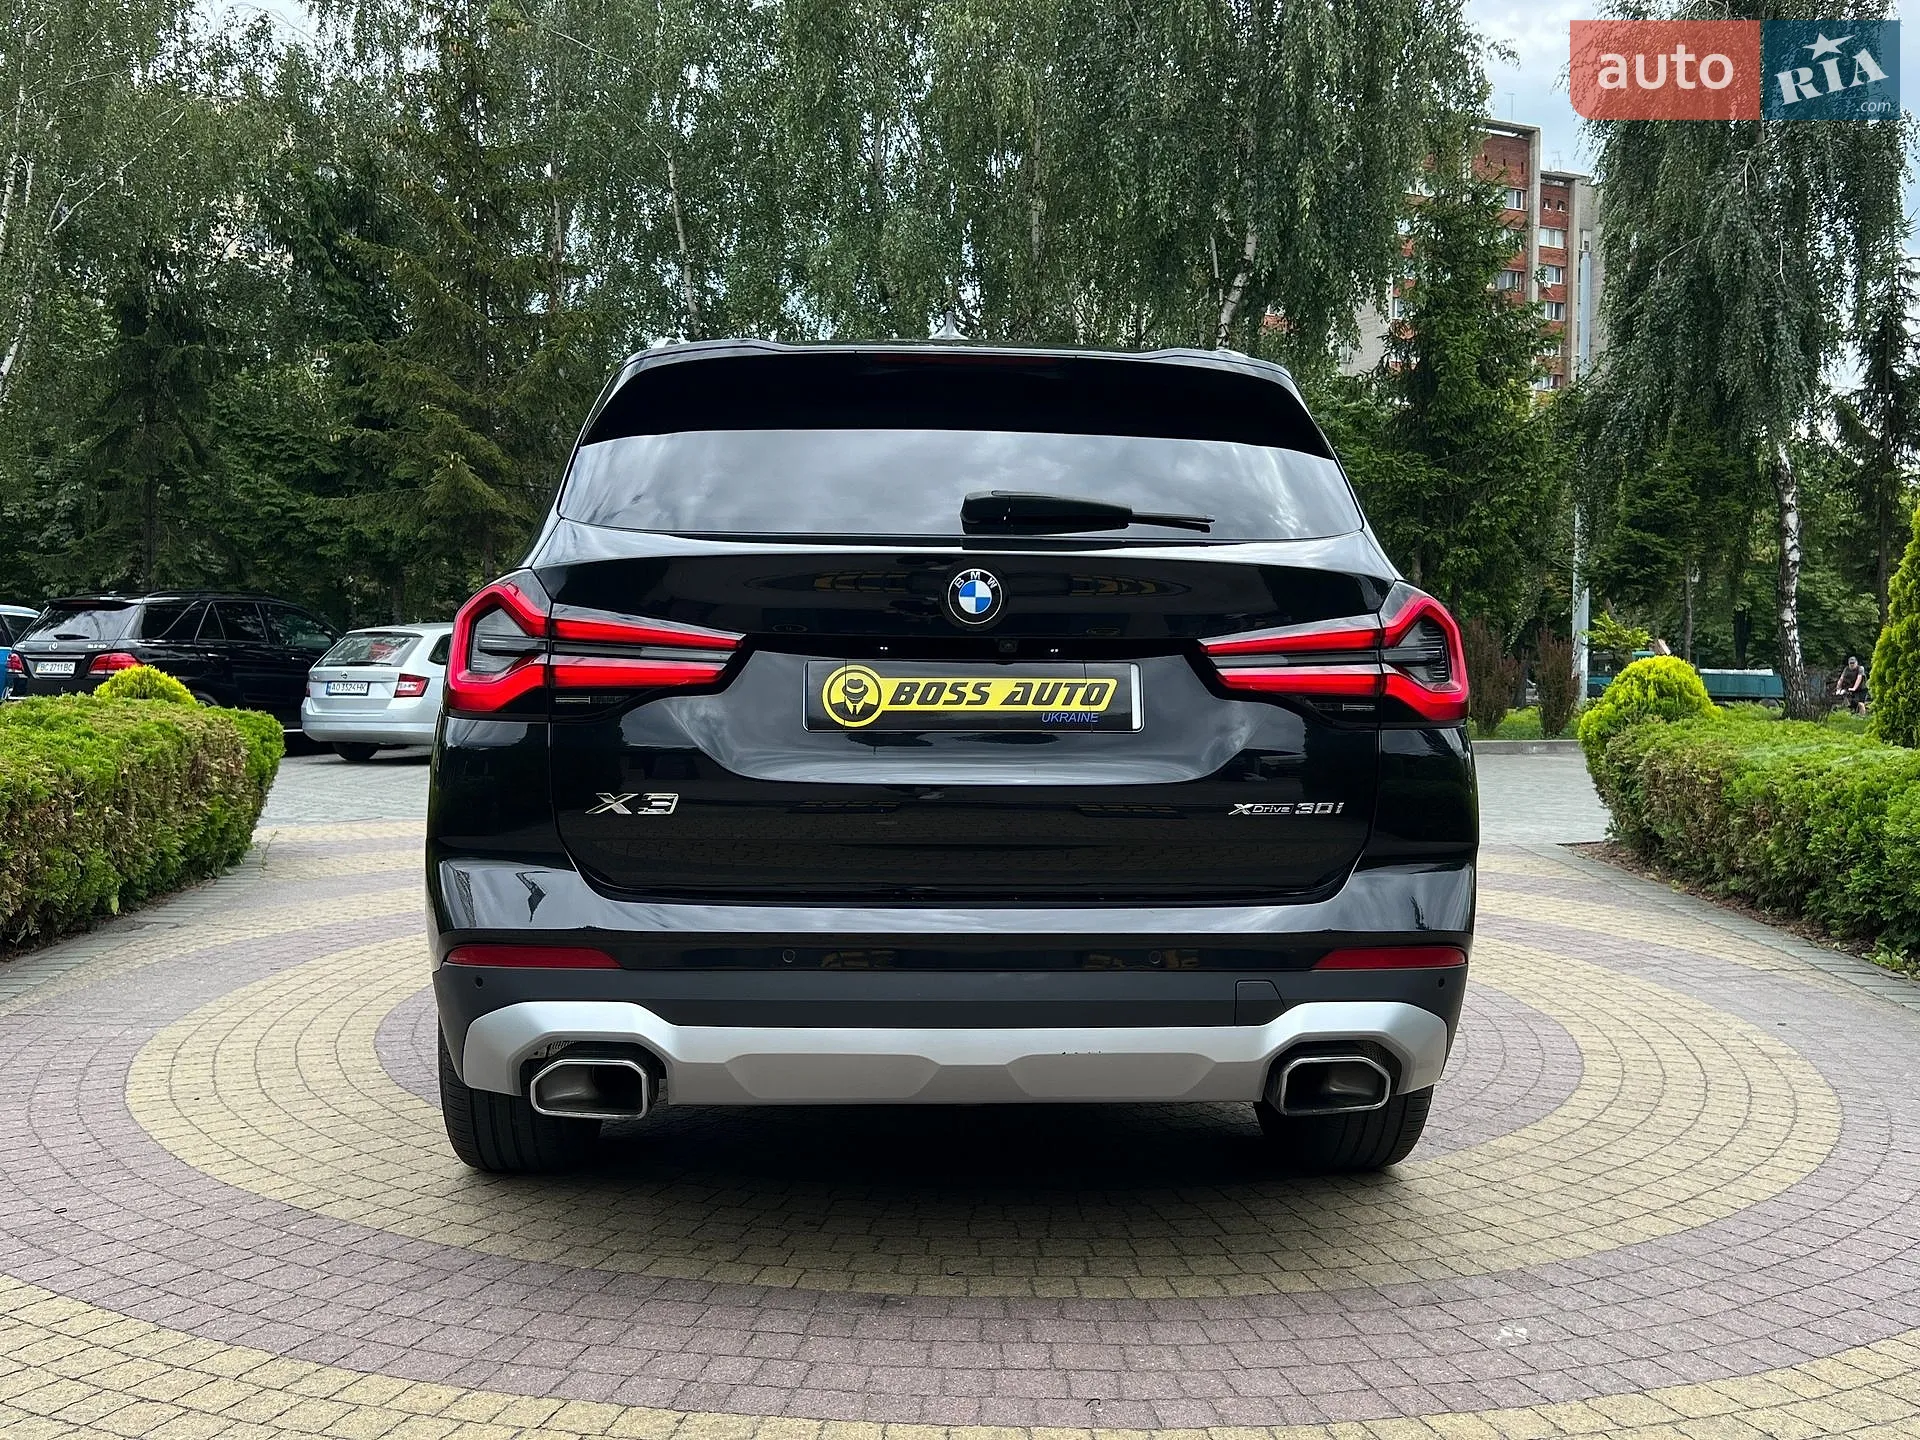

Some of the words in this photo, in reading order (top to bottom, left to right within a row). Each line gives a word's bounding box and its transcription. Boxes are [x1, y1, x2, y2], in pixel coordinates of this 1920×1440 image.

[953, 571, 998, 590] BMW
[888, 681, 992, 706] BOSS
[999, 682, 1111, 706] AUTO
[1041, 712, 1099, 723] UKRAINE
[584, 792, 679, 815] X3
